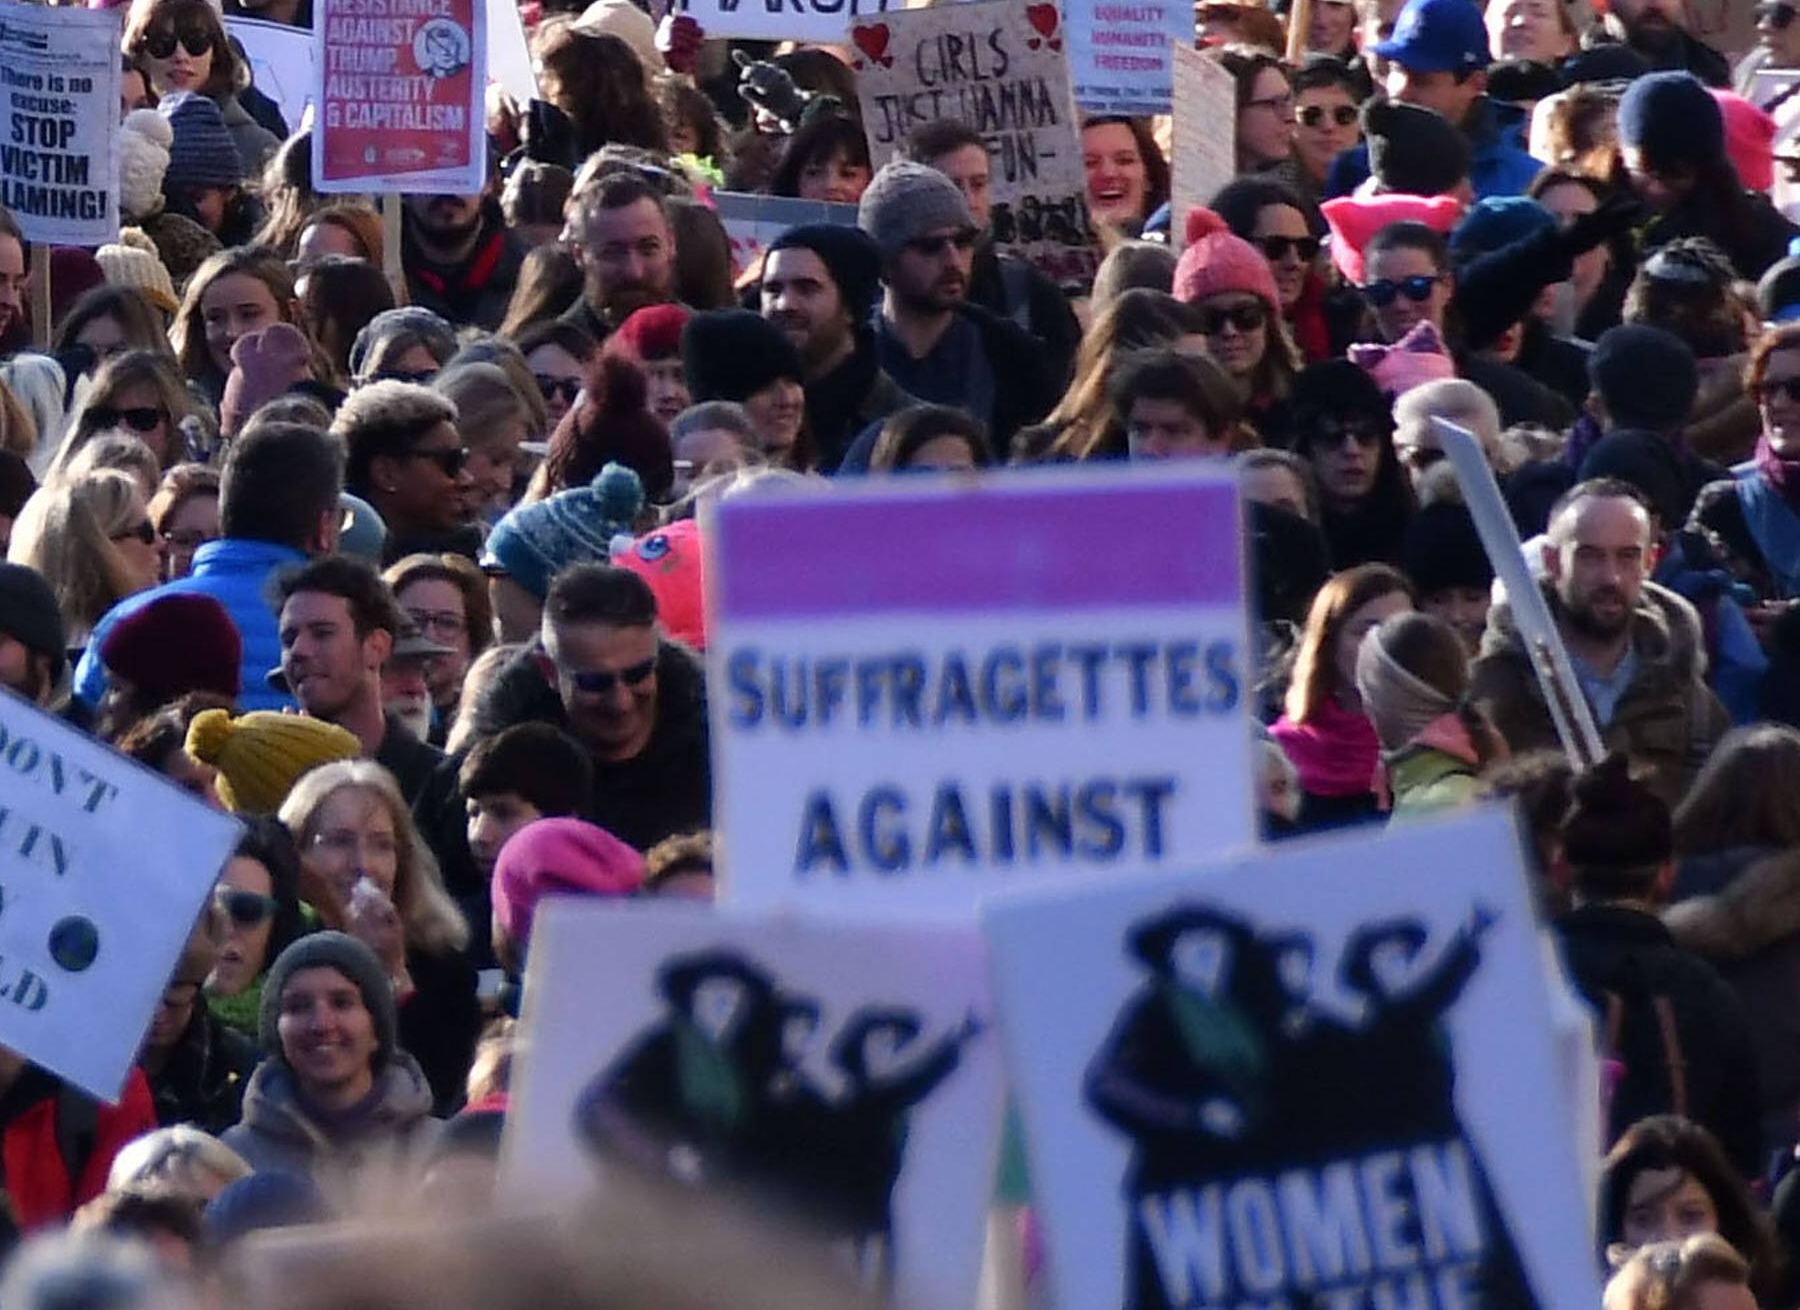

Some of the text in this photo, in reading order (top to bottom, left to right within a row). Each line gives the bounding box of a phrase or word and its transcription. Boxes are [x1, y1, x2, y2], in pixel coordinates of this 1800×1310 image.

[1095, 5, 1165, 23] EQUALITY
[328, 18, 416, 43] AGAINST
[1091, 30, 1166, 47] HUMANITY
[916, 27, 1011, 87] GIRLS
[1095, 54, 1163, 72] FREEDOM
[0, 66, 93, 93] There is no
[327, 75, 437, 100] AUSTERITY
[11, 92, 77, 114] excuse:
[351, 102, 465, 131] CAPITALISM
[11, 113, 75, 149] STOP
[1, 143, 89, 187] VICTIM
[725, 637, 1243, 731] SUFFRAGETTES
[795, 777, 1178, 878] AGAINST
[1138, 1137, 1488, 1307] WOMEN
